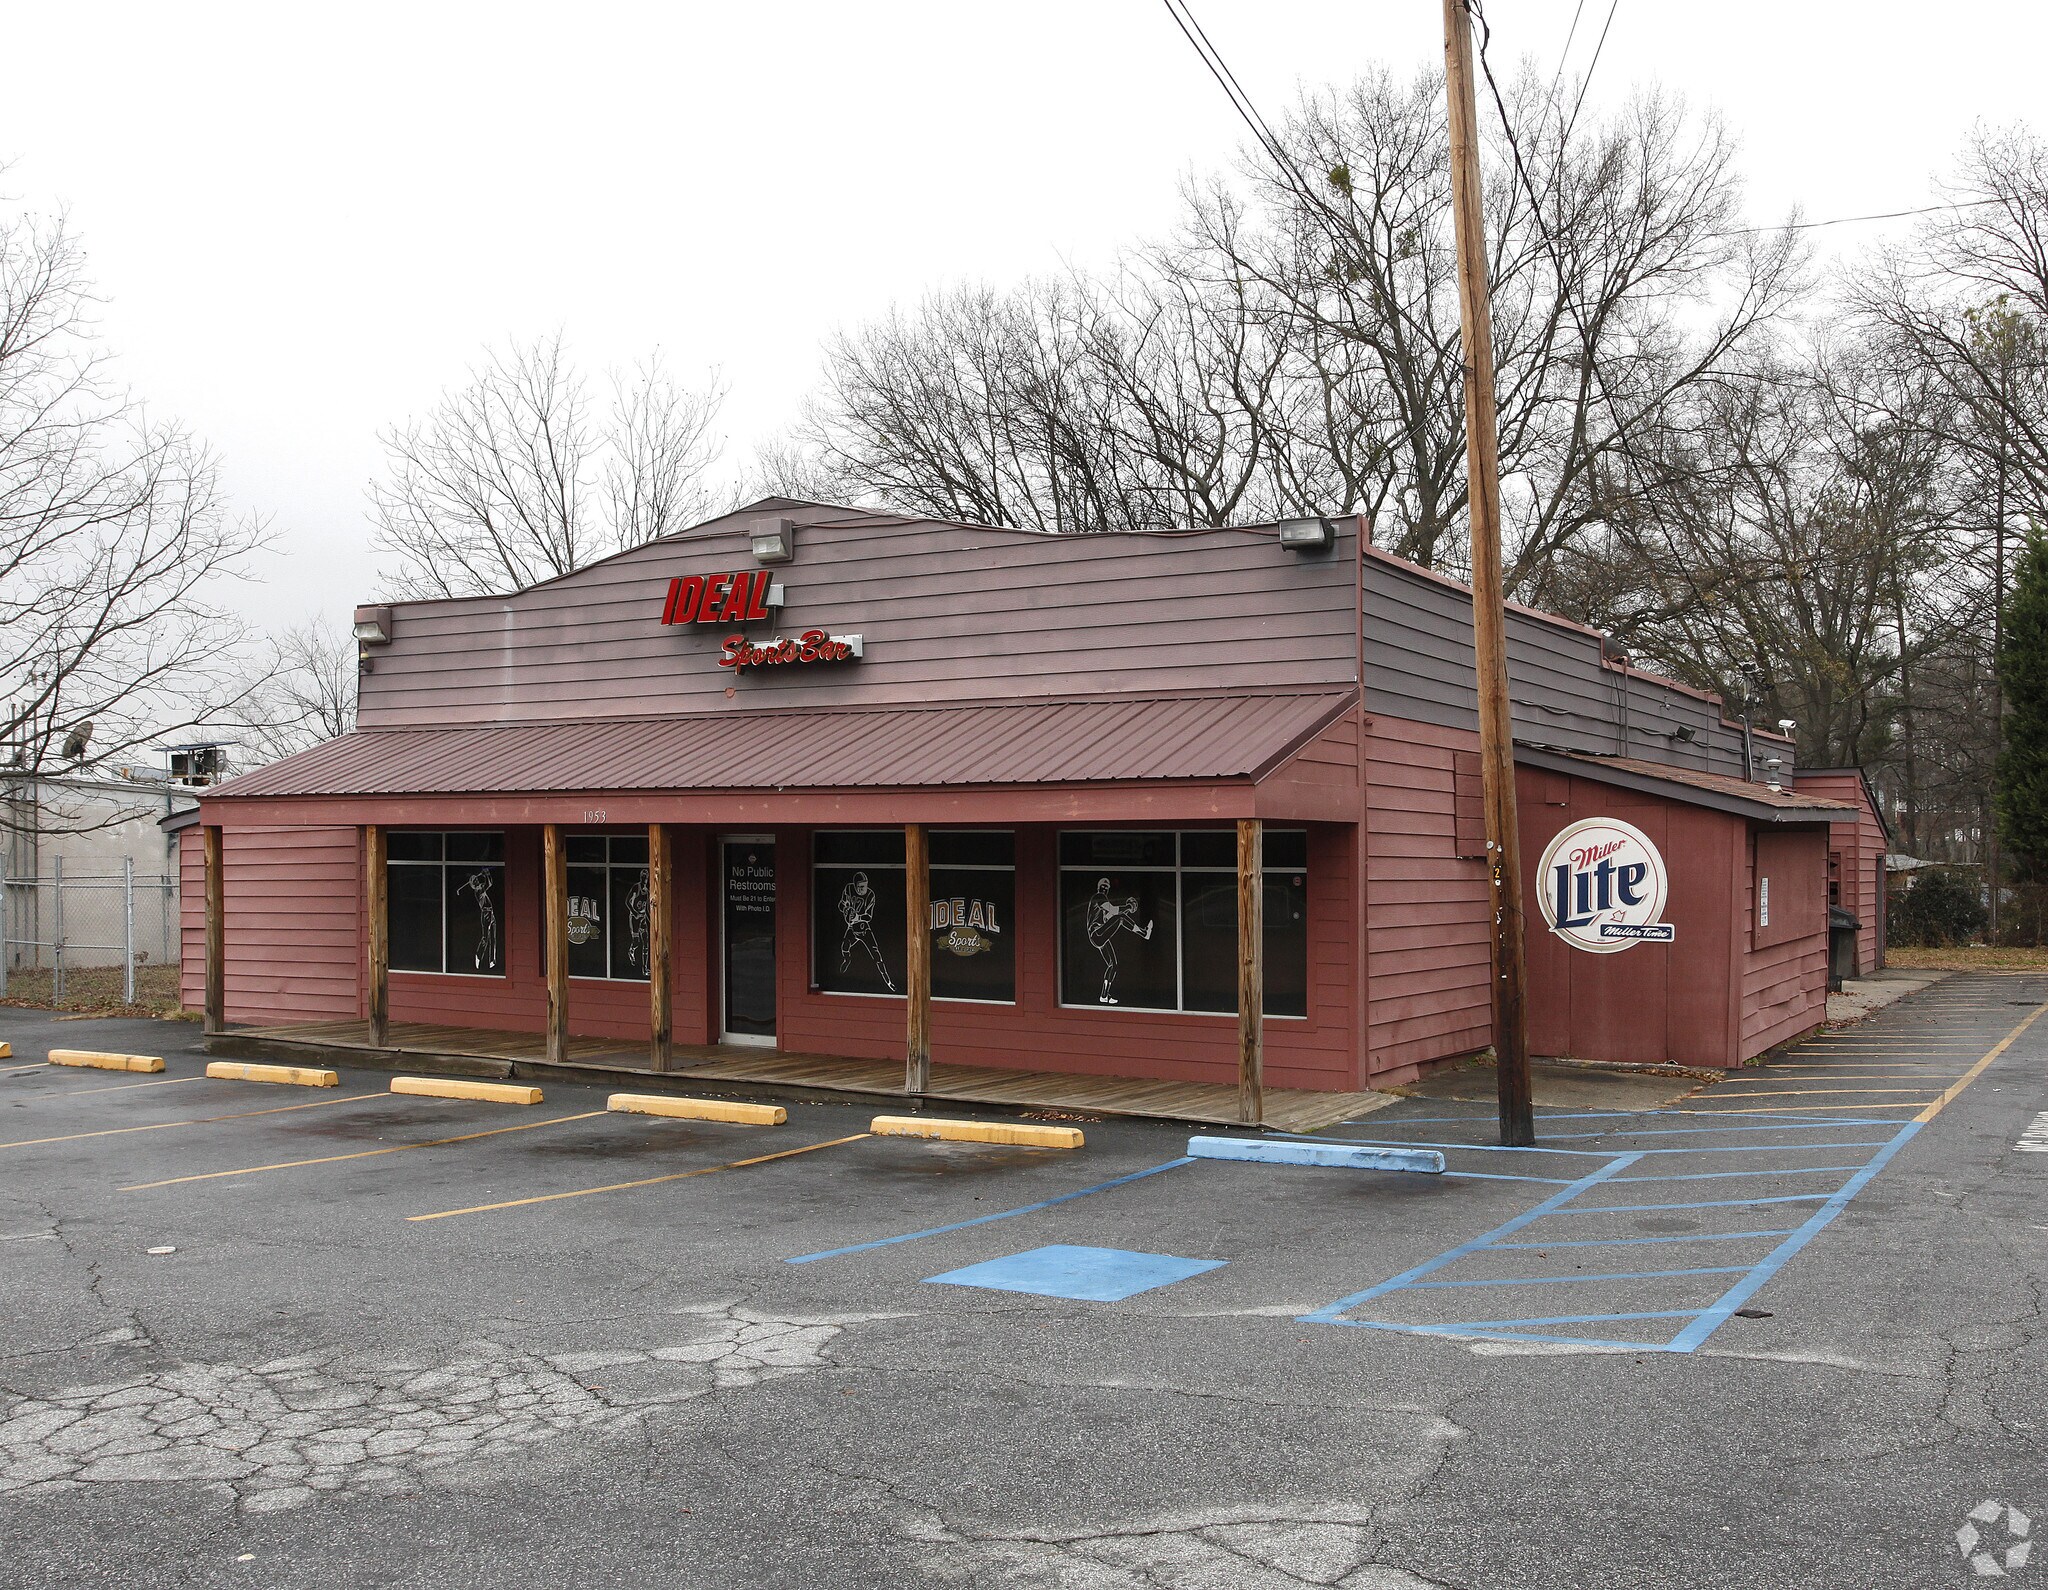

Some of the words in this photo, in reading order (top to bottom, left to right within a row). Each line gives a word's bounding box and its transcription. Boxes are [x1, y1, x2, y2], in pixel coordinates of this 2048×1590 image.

[661, 570, 770, 626] IDEAL
[718, 634, 798, 675] Sports
[799, 629, 851, 662] Bar
[583, 810, 606, 824] 1953
[1569, 839, 1627, 871] Miller
[732, 866, 745, 877] No
[747, 866, 774, 878] Public
[1494, 867, 1501, 878] 2
[729, 879, 777, 891] Restrooms
[729, 894, 742, 902] Must
[742, 894, 750, 902] Be
[1552, 857, 1649, 930] Lite
[747, 904, 762, 912] Photo
[1604, 926, 1641, 936] Miller
[1640, 928, 1669, 938] Time
[948, 931, 981, 947] Sports
